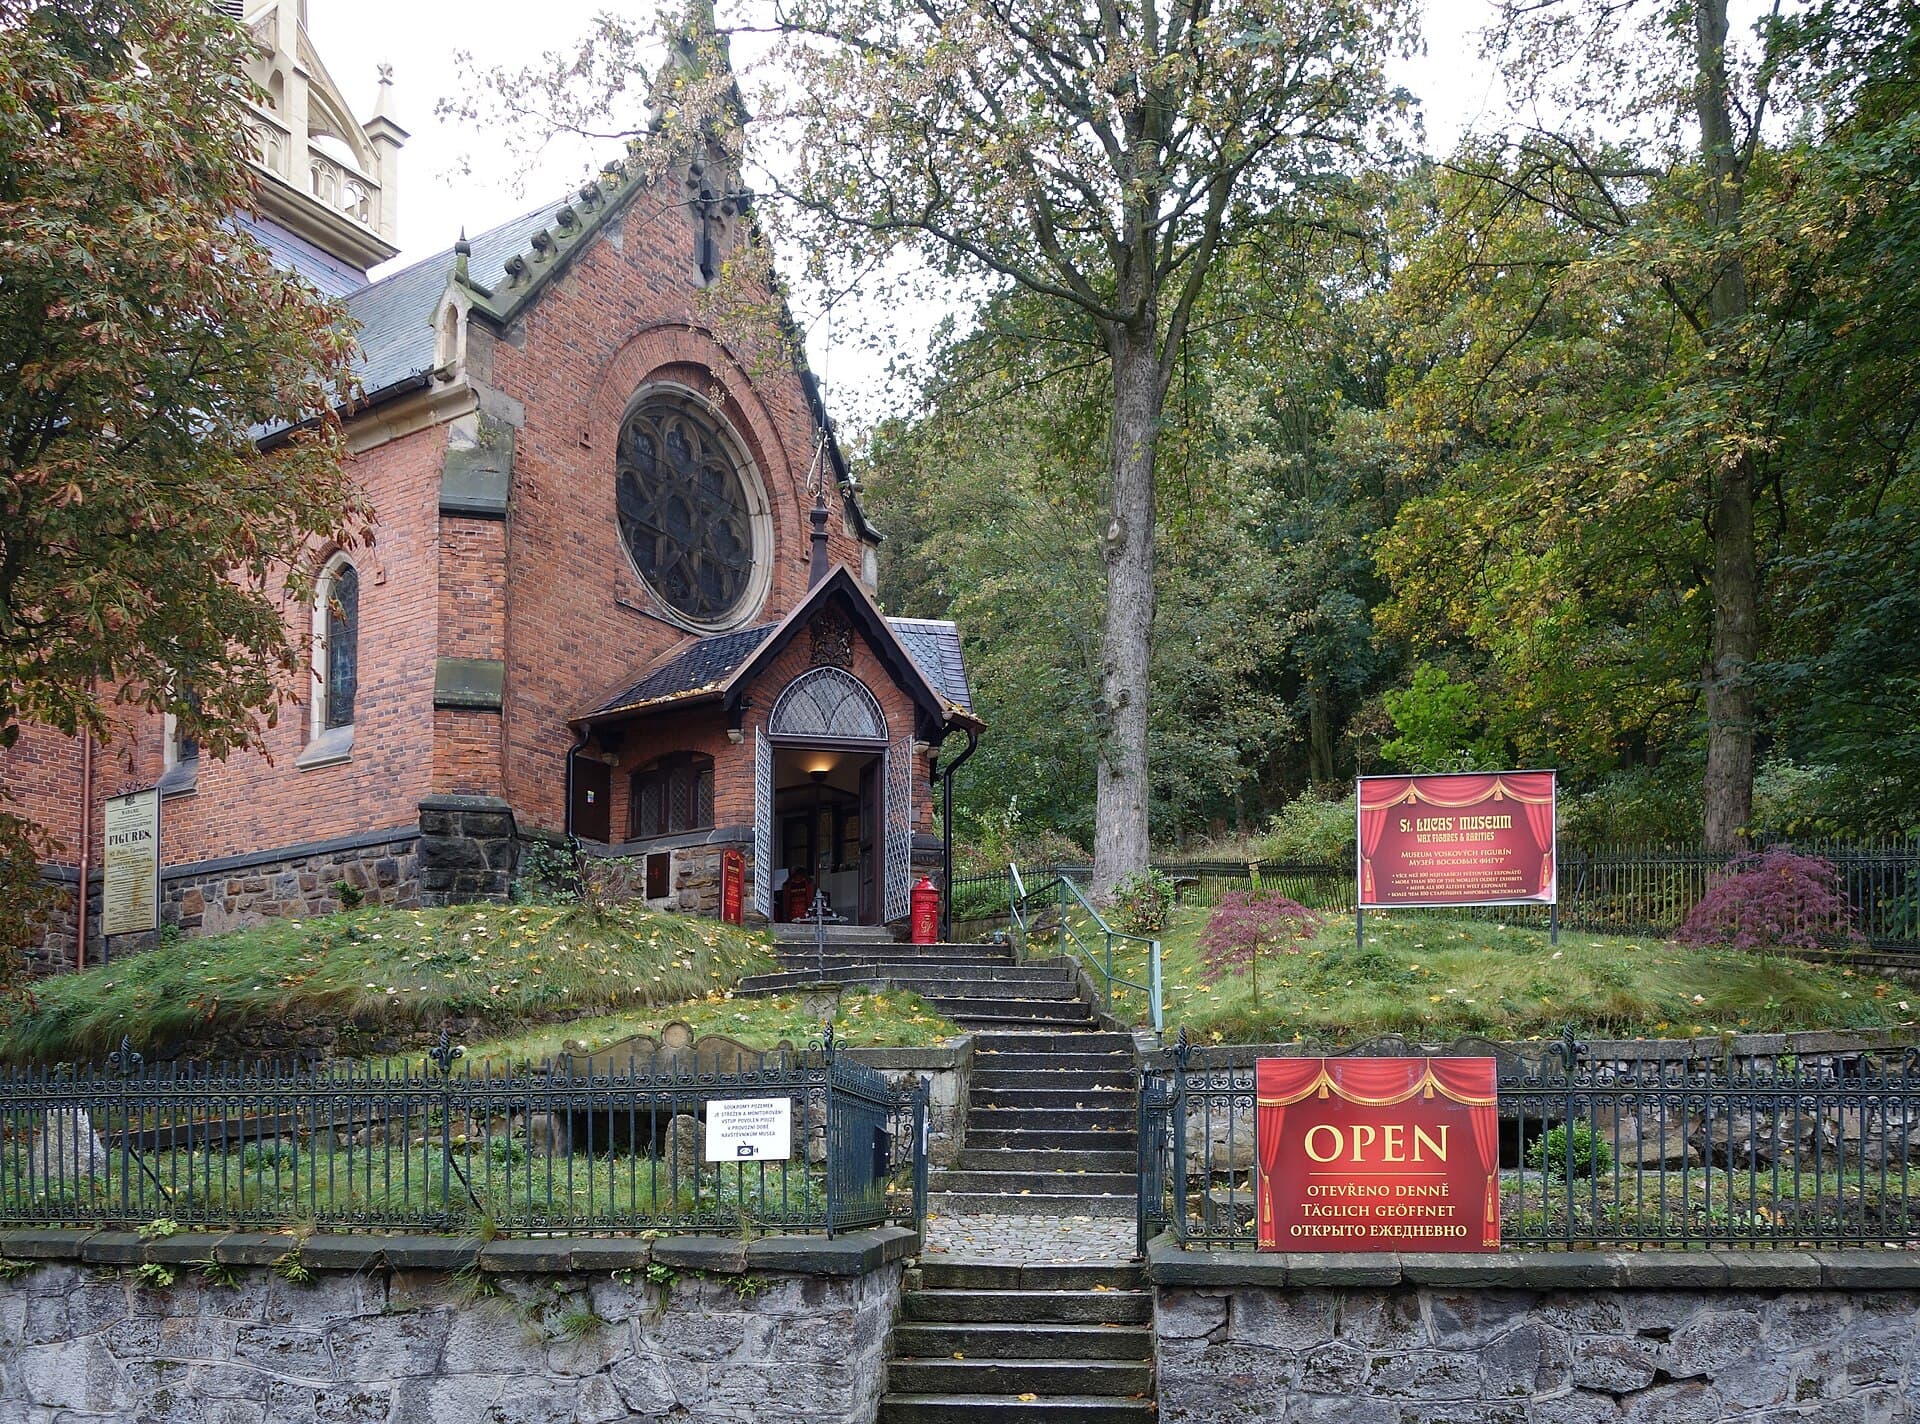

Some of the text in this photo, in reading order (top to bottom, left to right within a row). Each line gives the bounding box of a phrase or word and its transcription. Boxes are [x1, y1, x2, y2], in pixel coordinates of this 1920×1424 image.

[1400, 818, 1413, 832] St.
[1459, 815, 1512, 831] MUSEUM
[1416, 831, 1494, 843] WAX FIGURES & RARITIES
[1434, 848, 1478, 857] VOSKOVÝCH
[1480, 847, 1512, 856] FIGURÍN
[1436, 858, 1478, 866] ВОСКОВЫХ
[1479, 856, 1505, 864] ФИГУР
[1304, 1124, 1450, 1162] OPEN
[1307, 1182, 1449, 1197] OTEVŘENO DENNĚ
[1301, 1203, 1456, 1217] TÄGLICH GEÖFFNET
[1290, 1224, 1468, 1239] ОТКРЫТО ЕЖЕДНЕВНО
